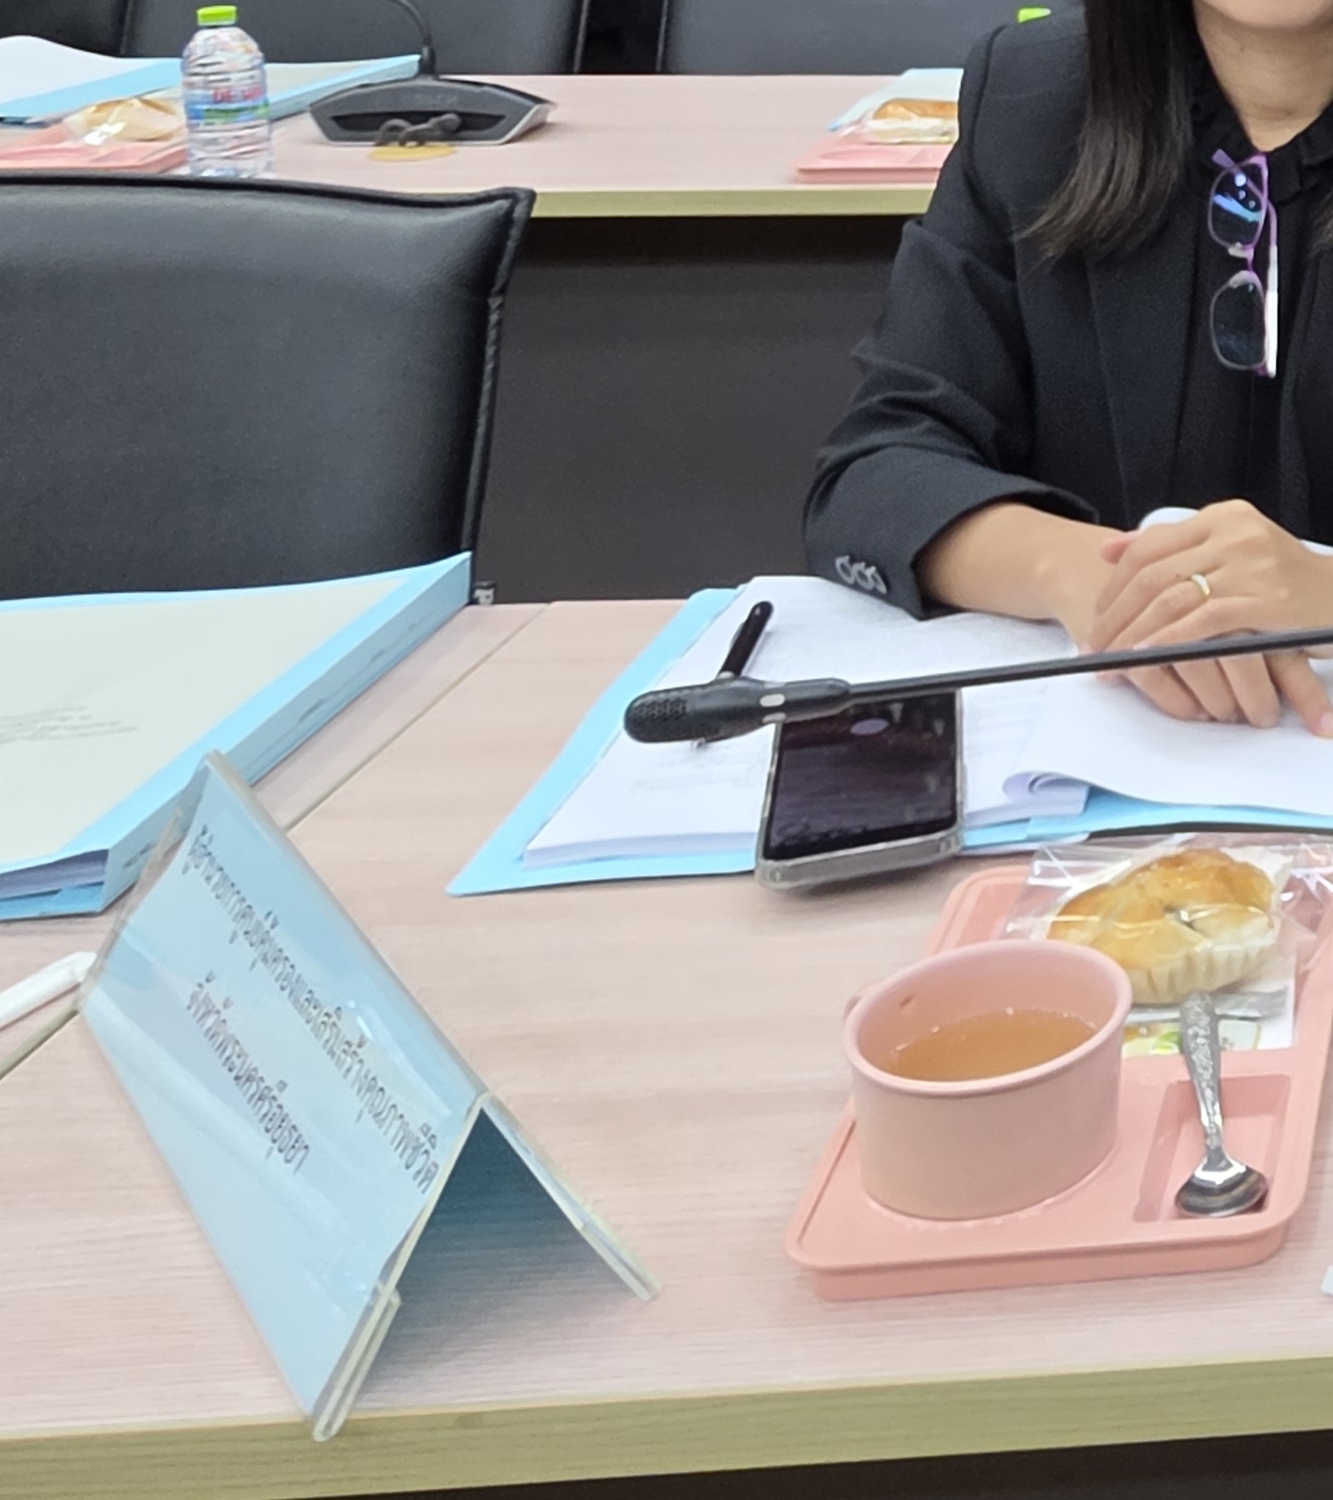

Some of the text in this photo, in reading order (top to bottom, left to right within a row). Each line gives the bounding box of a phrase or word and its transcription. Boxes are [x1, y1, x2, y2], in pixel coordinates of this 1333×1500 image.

[185, 969, 311, 1176] จังหวัดพระนครศรีอยุธยา
